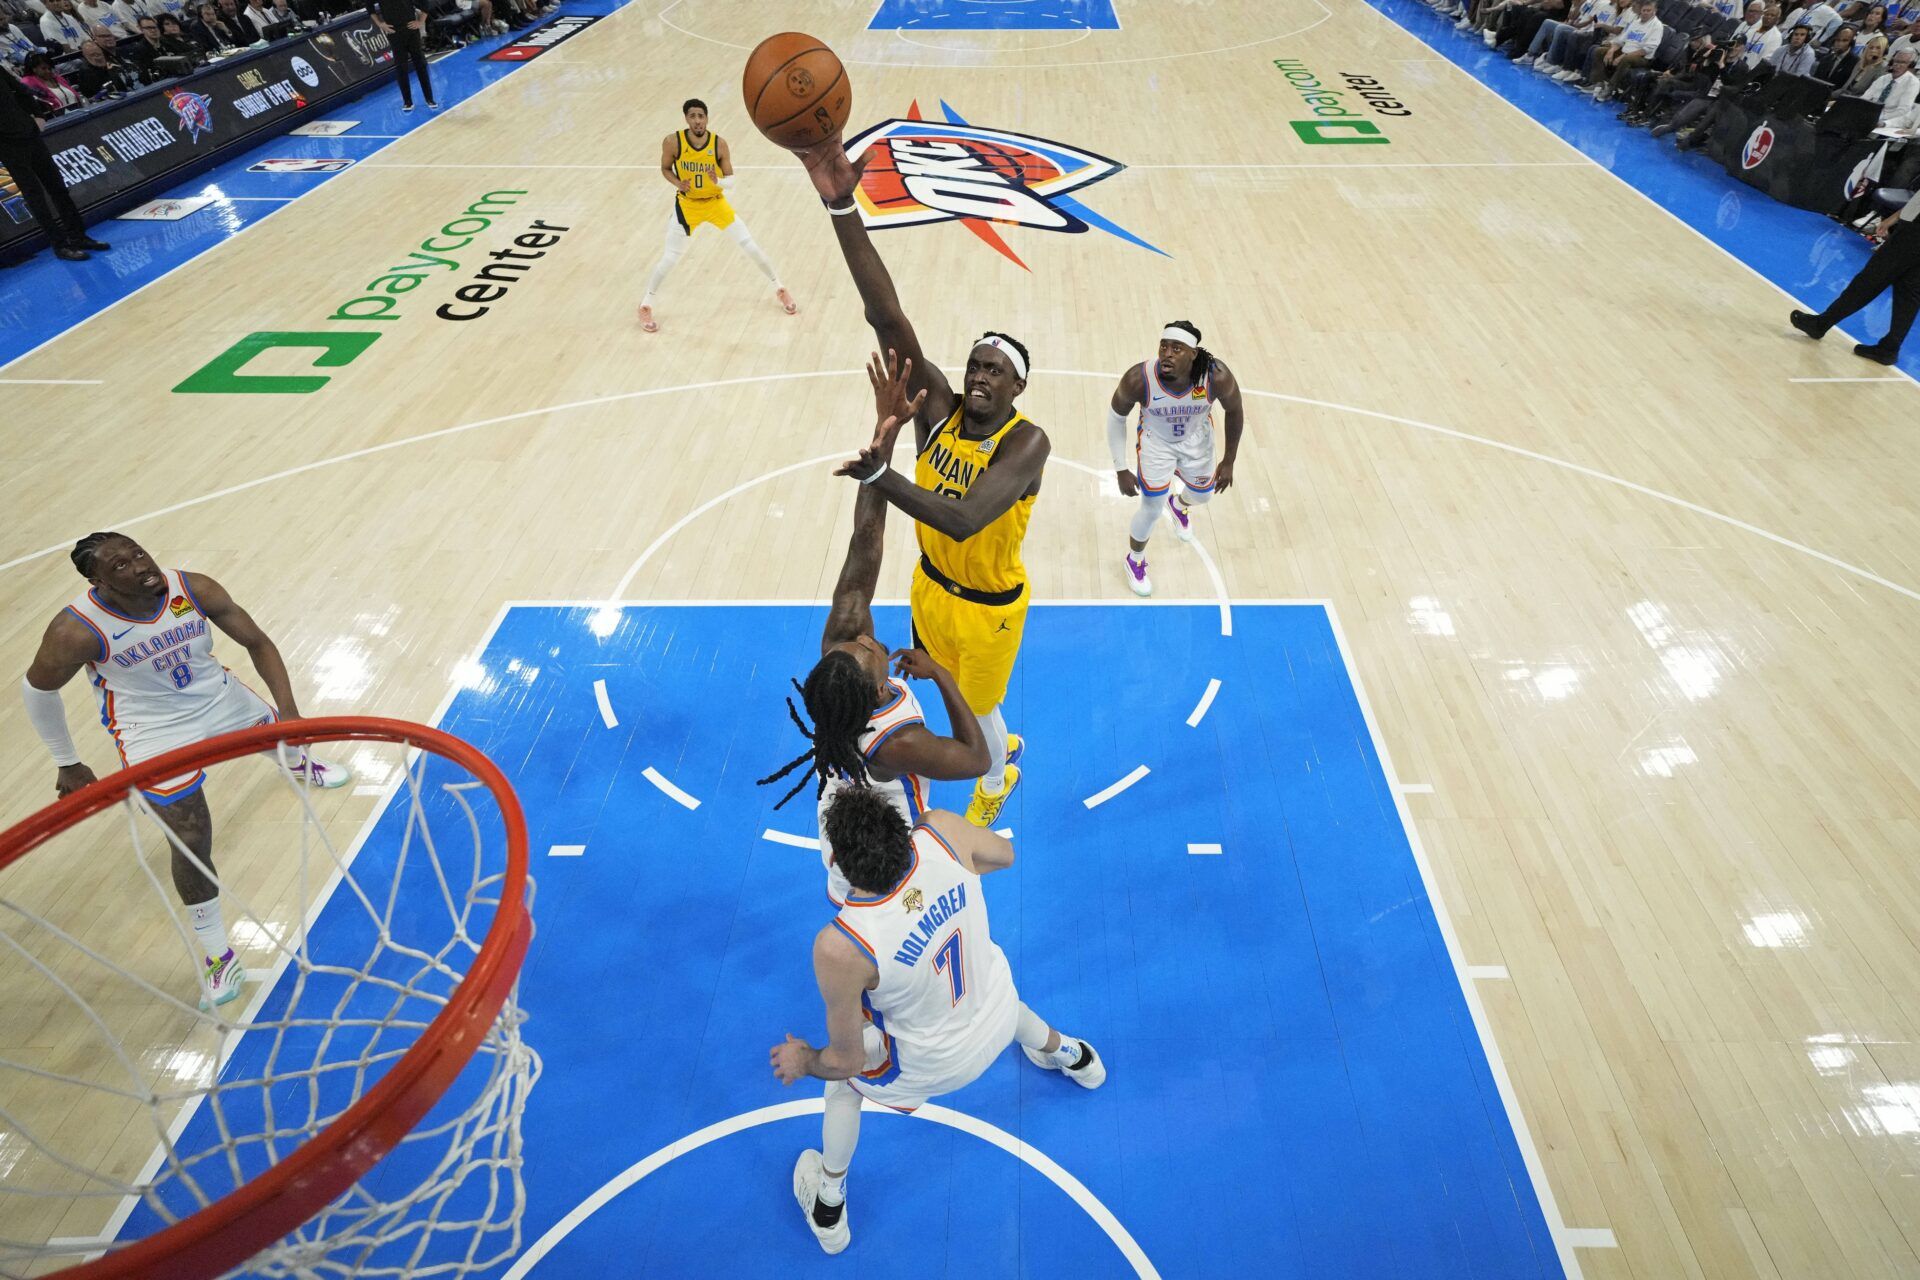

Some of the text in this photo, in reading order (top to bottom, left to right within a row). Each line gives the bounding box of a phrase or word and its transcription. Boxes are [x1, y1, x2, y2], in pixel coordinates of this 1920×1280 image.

[237, 68, 268, 91] GAME 2
[296, 65, 314, 78] abc
[263, 87, 280, 106] 8
[269, 82, 292, 104] PM
[1272, 59, 1363, 117] paycom
[1338, 72, 1412, 117] center
[232, 90, 272, 119] SUNDAY
[51, 144, 107, 188] ACERS
[101, 116, 177, 163] THUNDER
[680, 160, 716, 173] INDIANA
[694, 174, 703, 188] 0
[888, 139, 1069, 229] OKC
[326, 189, 528, 321] paycom
[435, 218, 570, 321] center
[1172, 424, 1185, 437] 5
[112, 618, 206, 668] OKLAHOMA
[152, 644, 193, 673] CITY
[169, 662, 194, 690] 8
[893, 882, 967, 967] HOLMGREN
[931, 927, 966, 1009] 7
